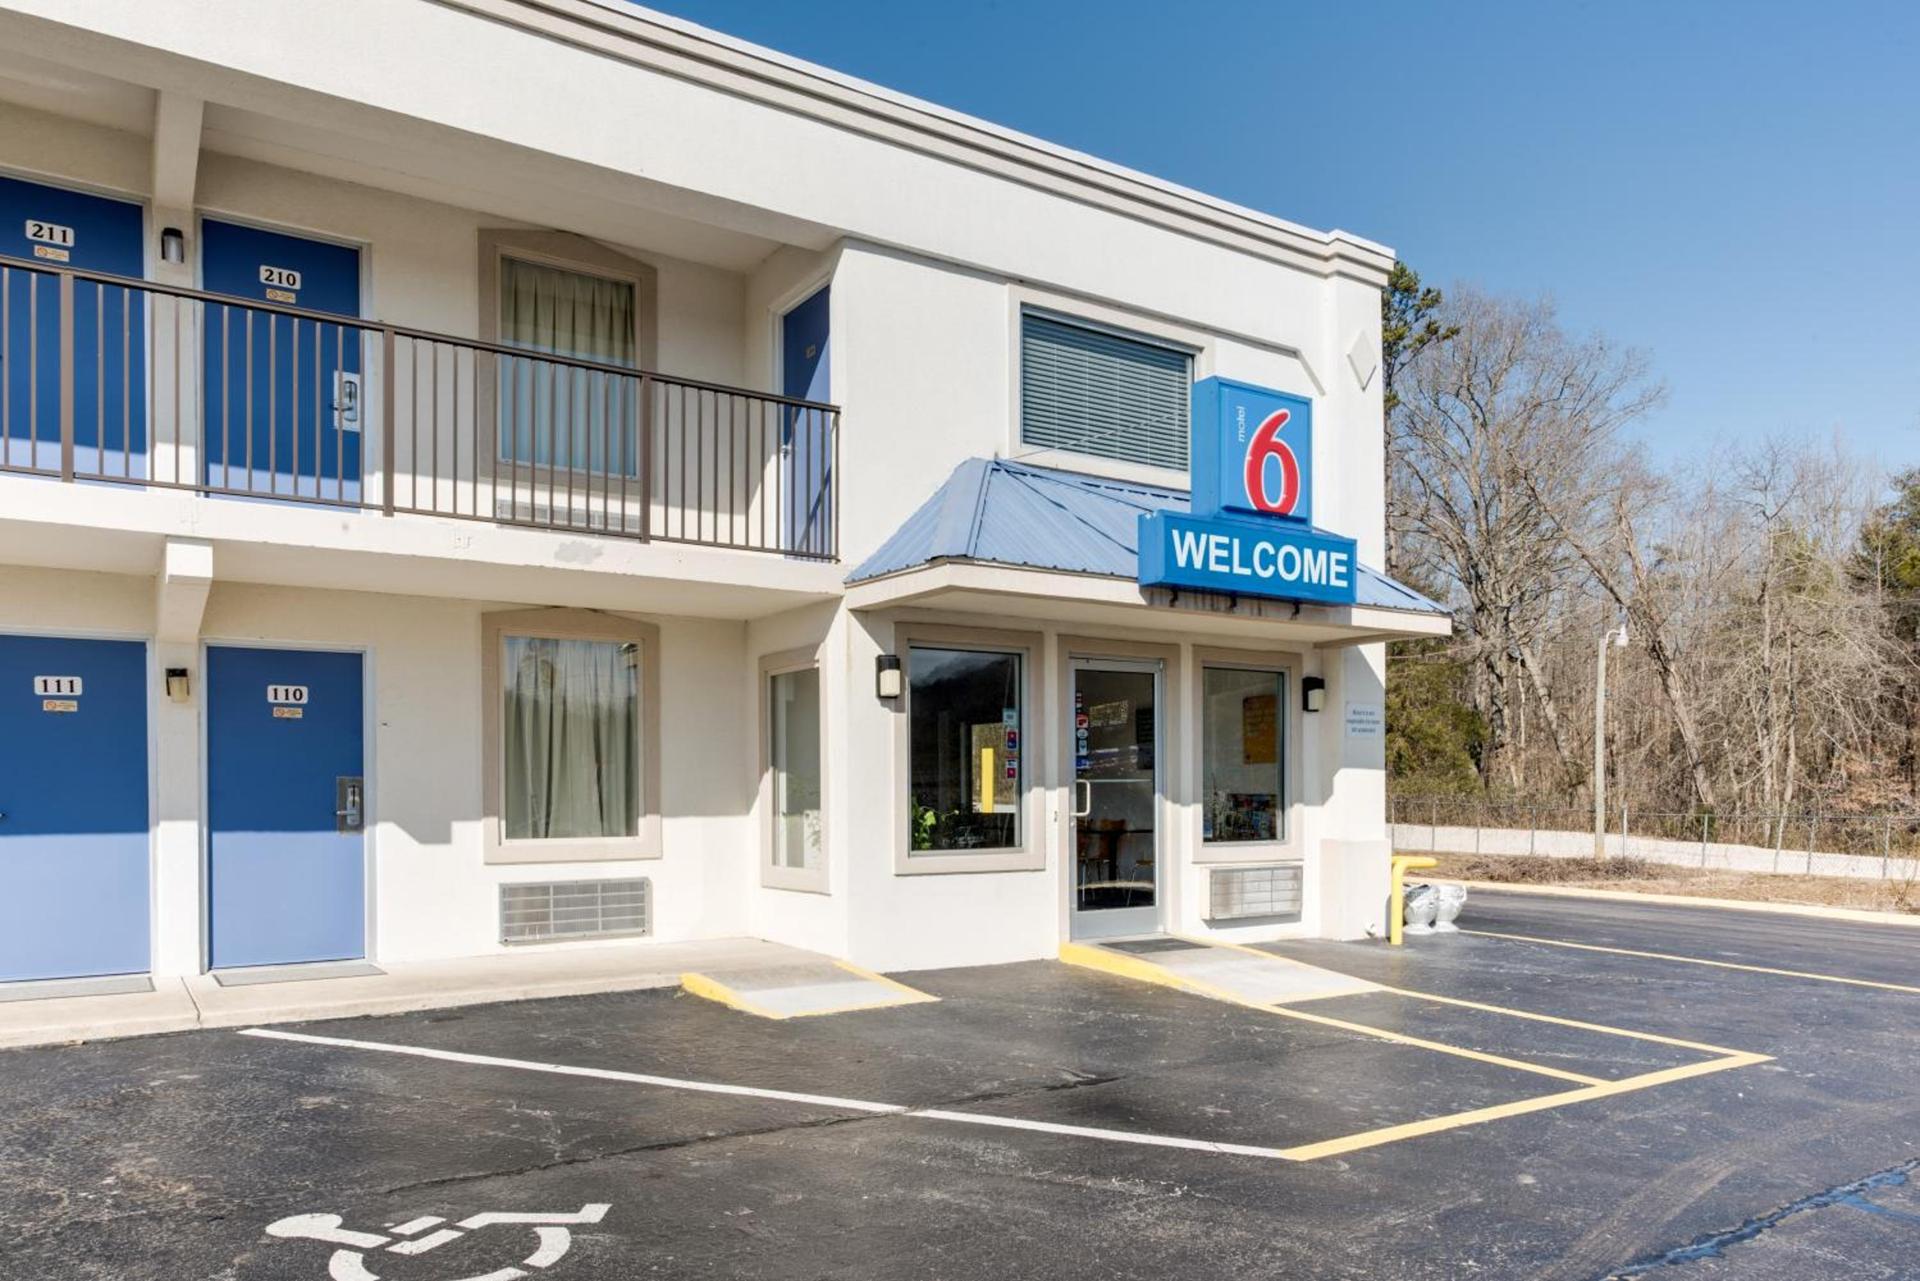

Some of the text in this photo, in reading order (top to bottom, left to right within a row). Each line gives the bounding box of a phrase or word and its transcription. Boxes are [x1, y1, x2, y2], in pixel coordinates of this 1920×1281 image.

[32, 223, 68, 244] 211
[264, 268, 297, 287] 210
[1235, 405, 1301, 516] motel 6
[1172, 529, 1349, 588] WELCOME
[41, 678, 75, 693] 111
[272, 687, 303, 702] 110
